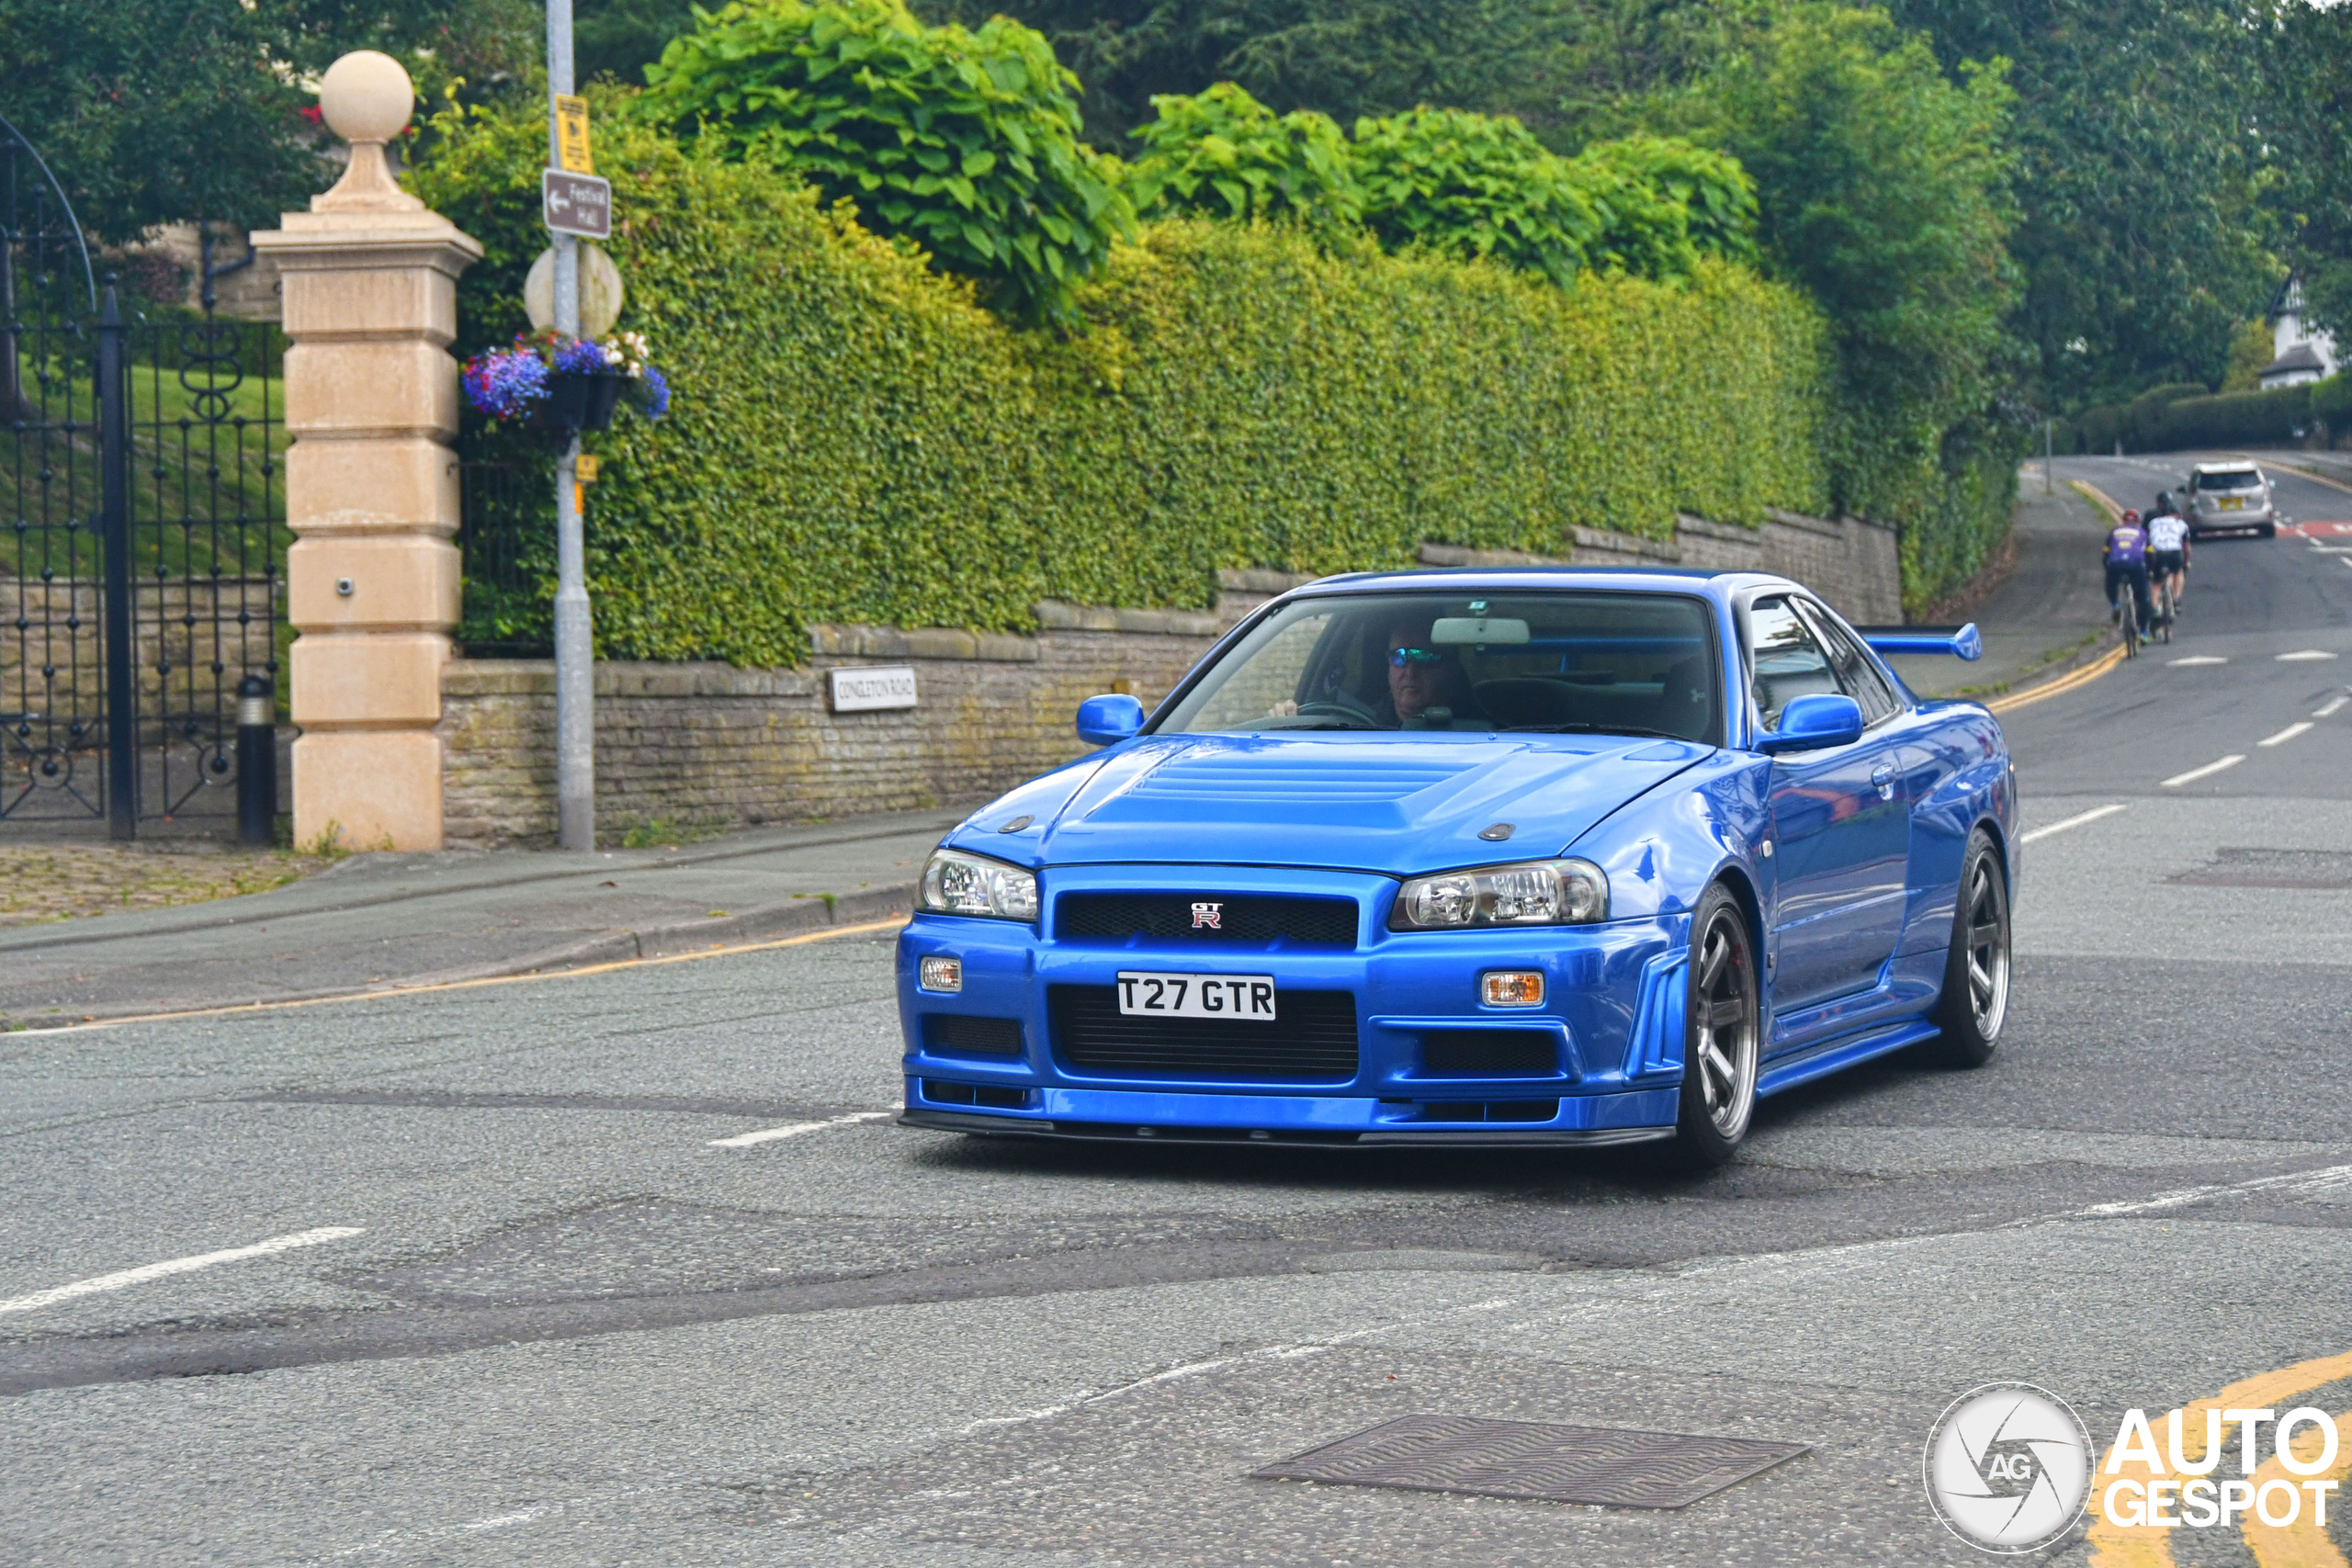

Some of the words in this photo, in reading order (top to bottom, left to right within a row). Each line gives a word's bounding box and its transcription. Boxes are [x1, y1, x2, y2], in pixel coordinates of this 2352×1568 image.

[838, 680, 888, 699] CONGLETON
[889, 678, 912, 695] ROAD
[1118, 977, 1188, 1010] T27
[1202, 980, 1272, 1014] GTR
